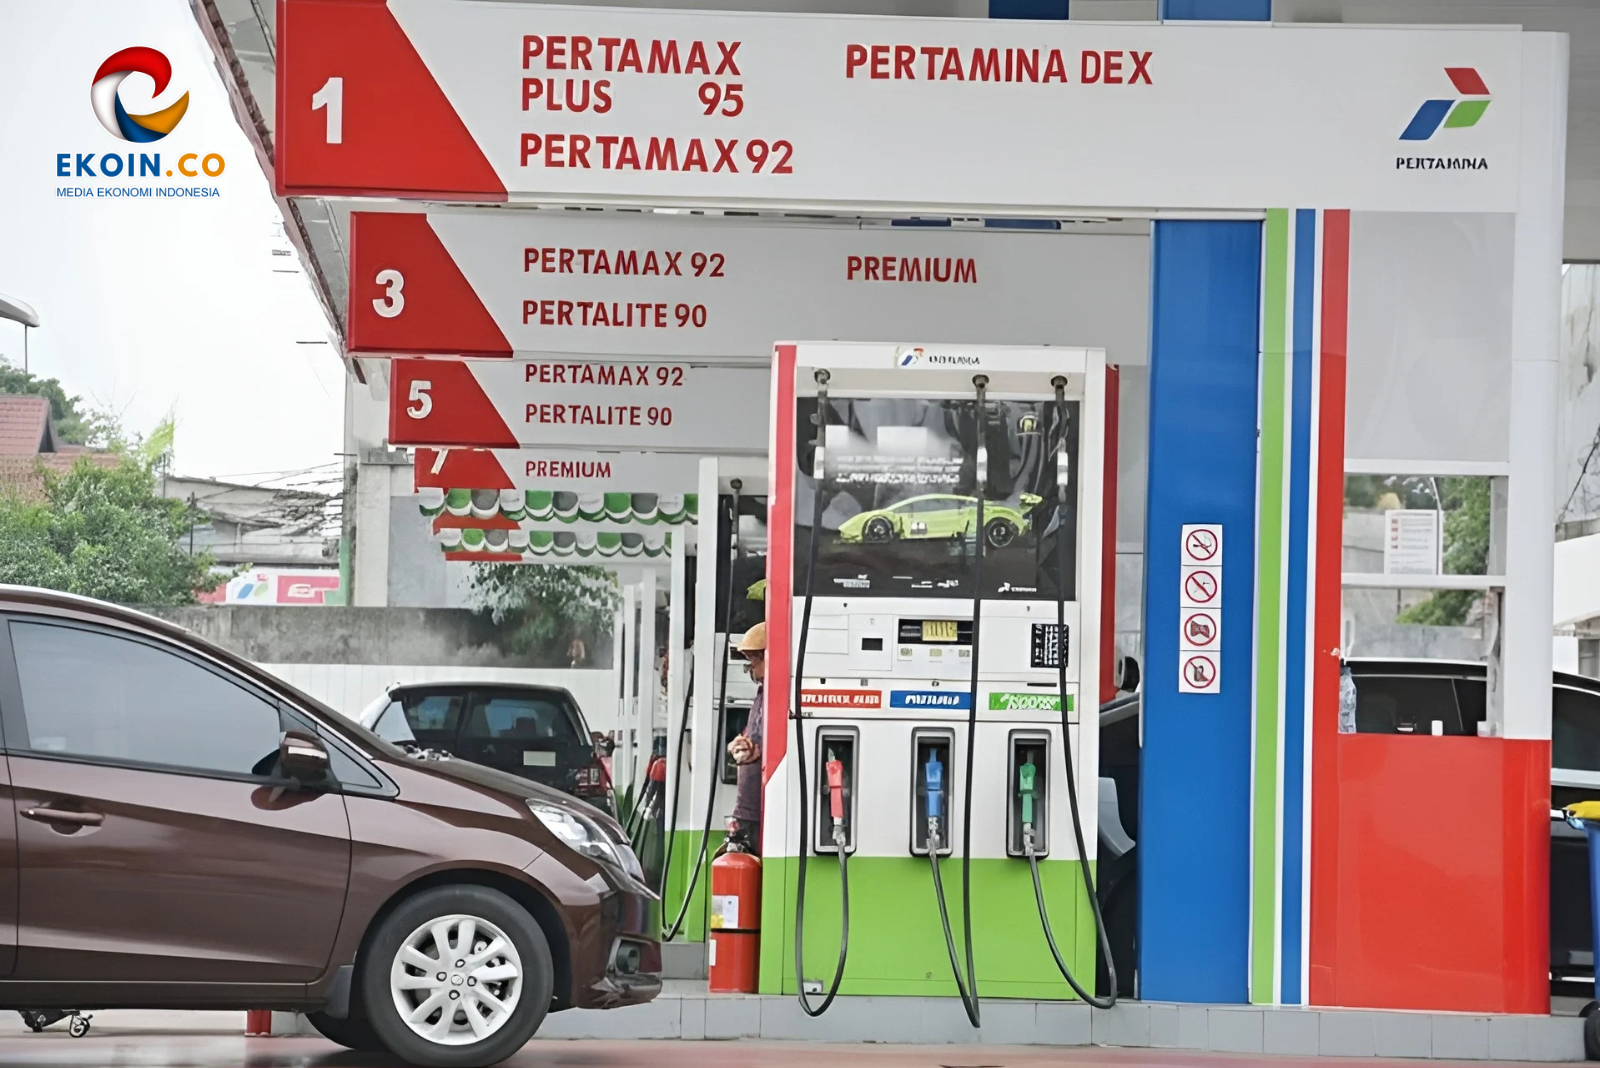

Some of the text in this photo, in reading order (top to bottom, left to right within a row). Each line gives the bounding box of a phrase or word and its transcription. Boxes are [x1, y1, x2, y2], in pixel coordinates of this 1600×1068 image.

[522, 35, 742, 76] PERTAMAX
[846, 44, 1153, 85] PERTAMINA DEX
[311, 76, 343, 144] 1
[521, 79, 744, 117] PLUS 95
[520, 133, 794, 174] PERTAMAX 92
[524, 247, 725, 277] PERTAMAX 92
[847, 256, 978, 283] PREMIUM
[372, 269, 405, 318] 3
[523, 300, 708, 328] PERTALITE 90
[525, 364, 684, 386] PERTAMAX 92
[406, 380, 433, 419] 5
[525, 404, 672, 426] PERTALITE 90
[525, 461, 611, 479] PREMIUM
